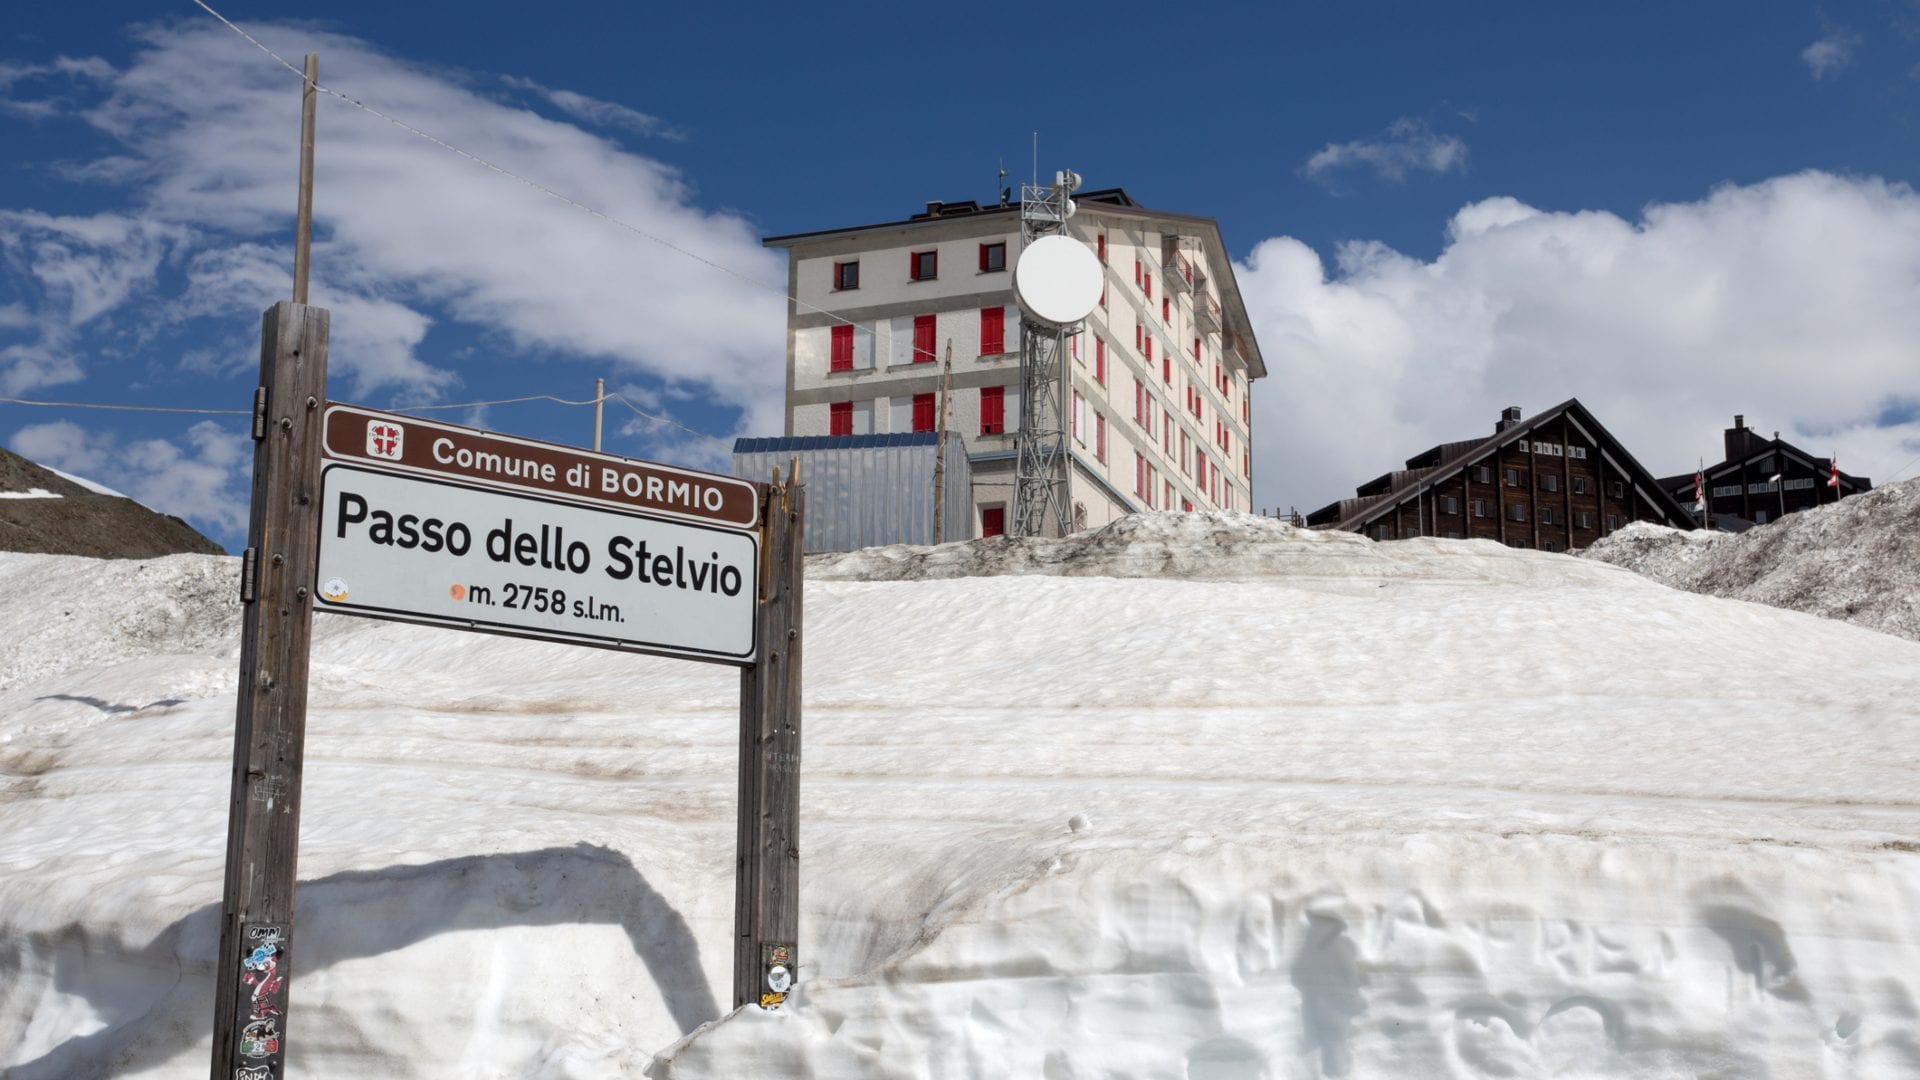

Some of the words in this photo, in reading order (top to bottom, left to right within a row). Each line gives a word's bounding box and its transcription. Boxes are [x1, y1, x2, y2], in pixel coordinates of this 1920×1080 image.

[433, 438, 555, 482] Comune
[566, 463, 590, 489] di
[601, 467, 724, 512] BORMIO
[337, 491, 471, 556] Passo
[486, 518, 591, 575] dello
[604, 535, 742, 597] Stelvio
[468, 585, 496, 606] m.
[502, 582, 566, 615] 2758
[573, 600, 625, 623] s.l.m.
